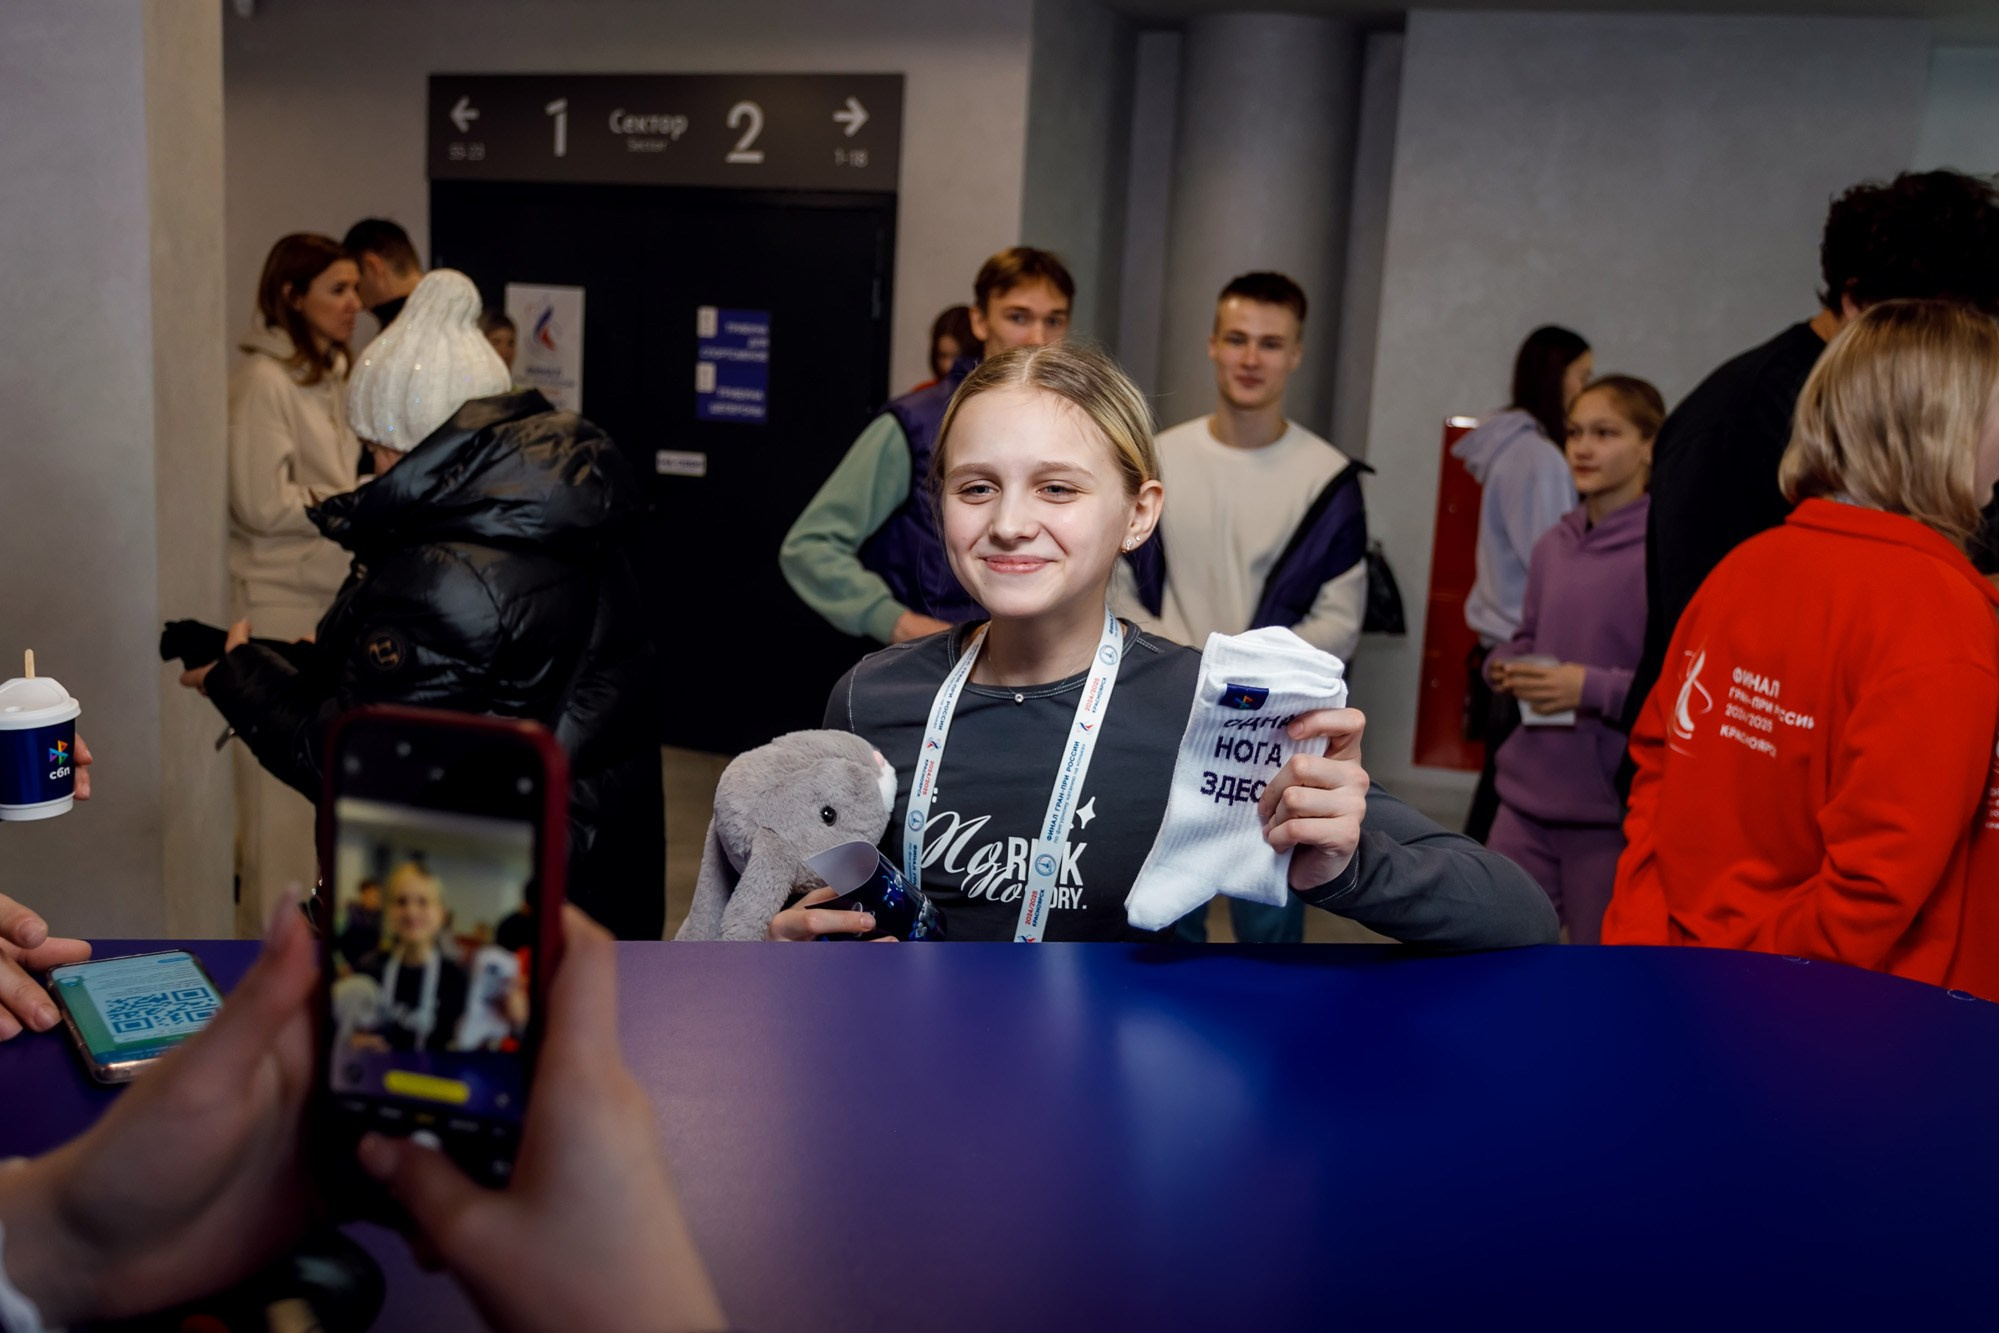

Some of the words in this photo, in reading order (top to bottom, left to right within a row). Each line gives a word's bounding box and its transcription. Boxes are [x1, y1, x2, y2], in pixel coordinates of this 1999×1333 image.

[545, 98, 568, 157] 1
[608, 108, 689, 141] Сектор
[725, 101, 765, 164] 2
[1214, 736, 1282, 768] НОГА
[49, 766, 71, 780] сбп
[1200, 771, 1267, 806] ЗДЕС
[1047, 814, 1058, 841] ФИНАЛ
[1054, 775, 1070, 811] ГРАН-ПРИ
[1066, 741, 1080, 772] РОССИИ
[1025, 890, 1038, 925] 2024/2025
